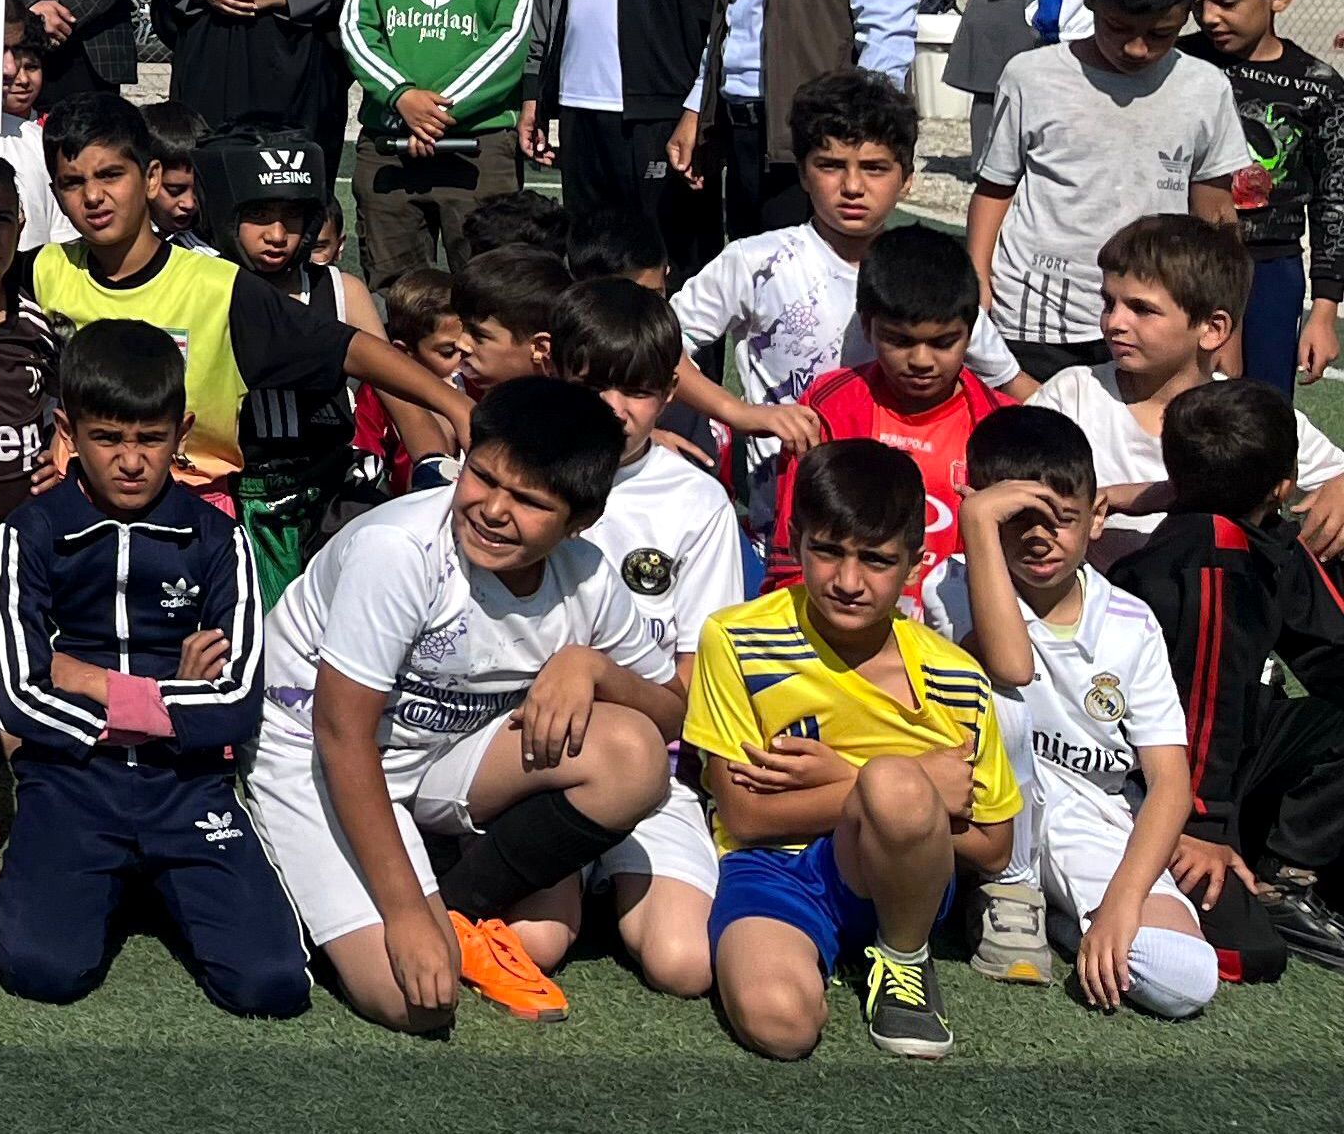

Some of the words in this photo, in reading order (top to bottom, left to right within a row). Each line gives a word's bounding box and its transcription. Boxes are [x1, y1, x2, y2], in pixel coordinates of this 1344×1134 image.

[1240, 67, 1291, 88] SIGNO
[258, 171, 312, 185] WESING
[1031, 253, 1070, 273] SPORT
[1031, 731, 1131, 772] mirates
